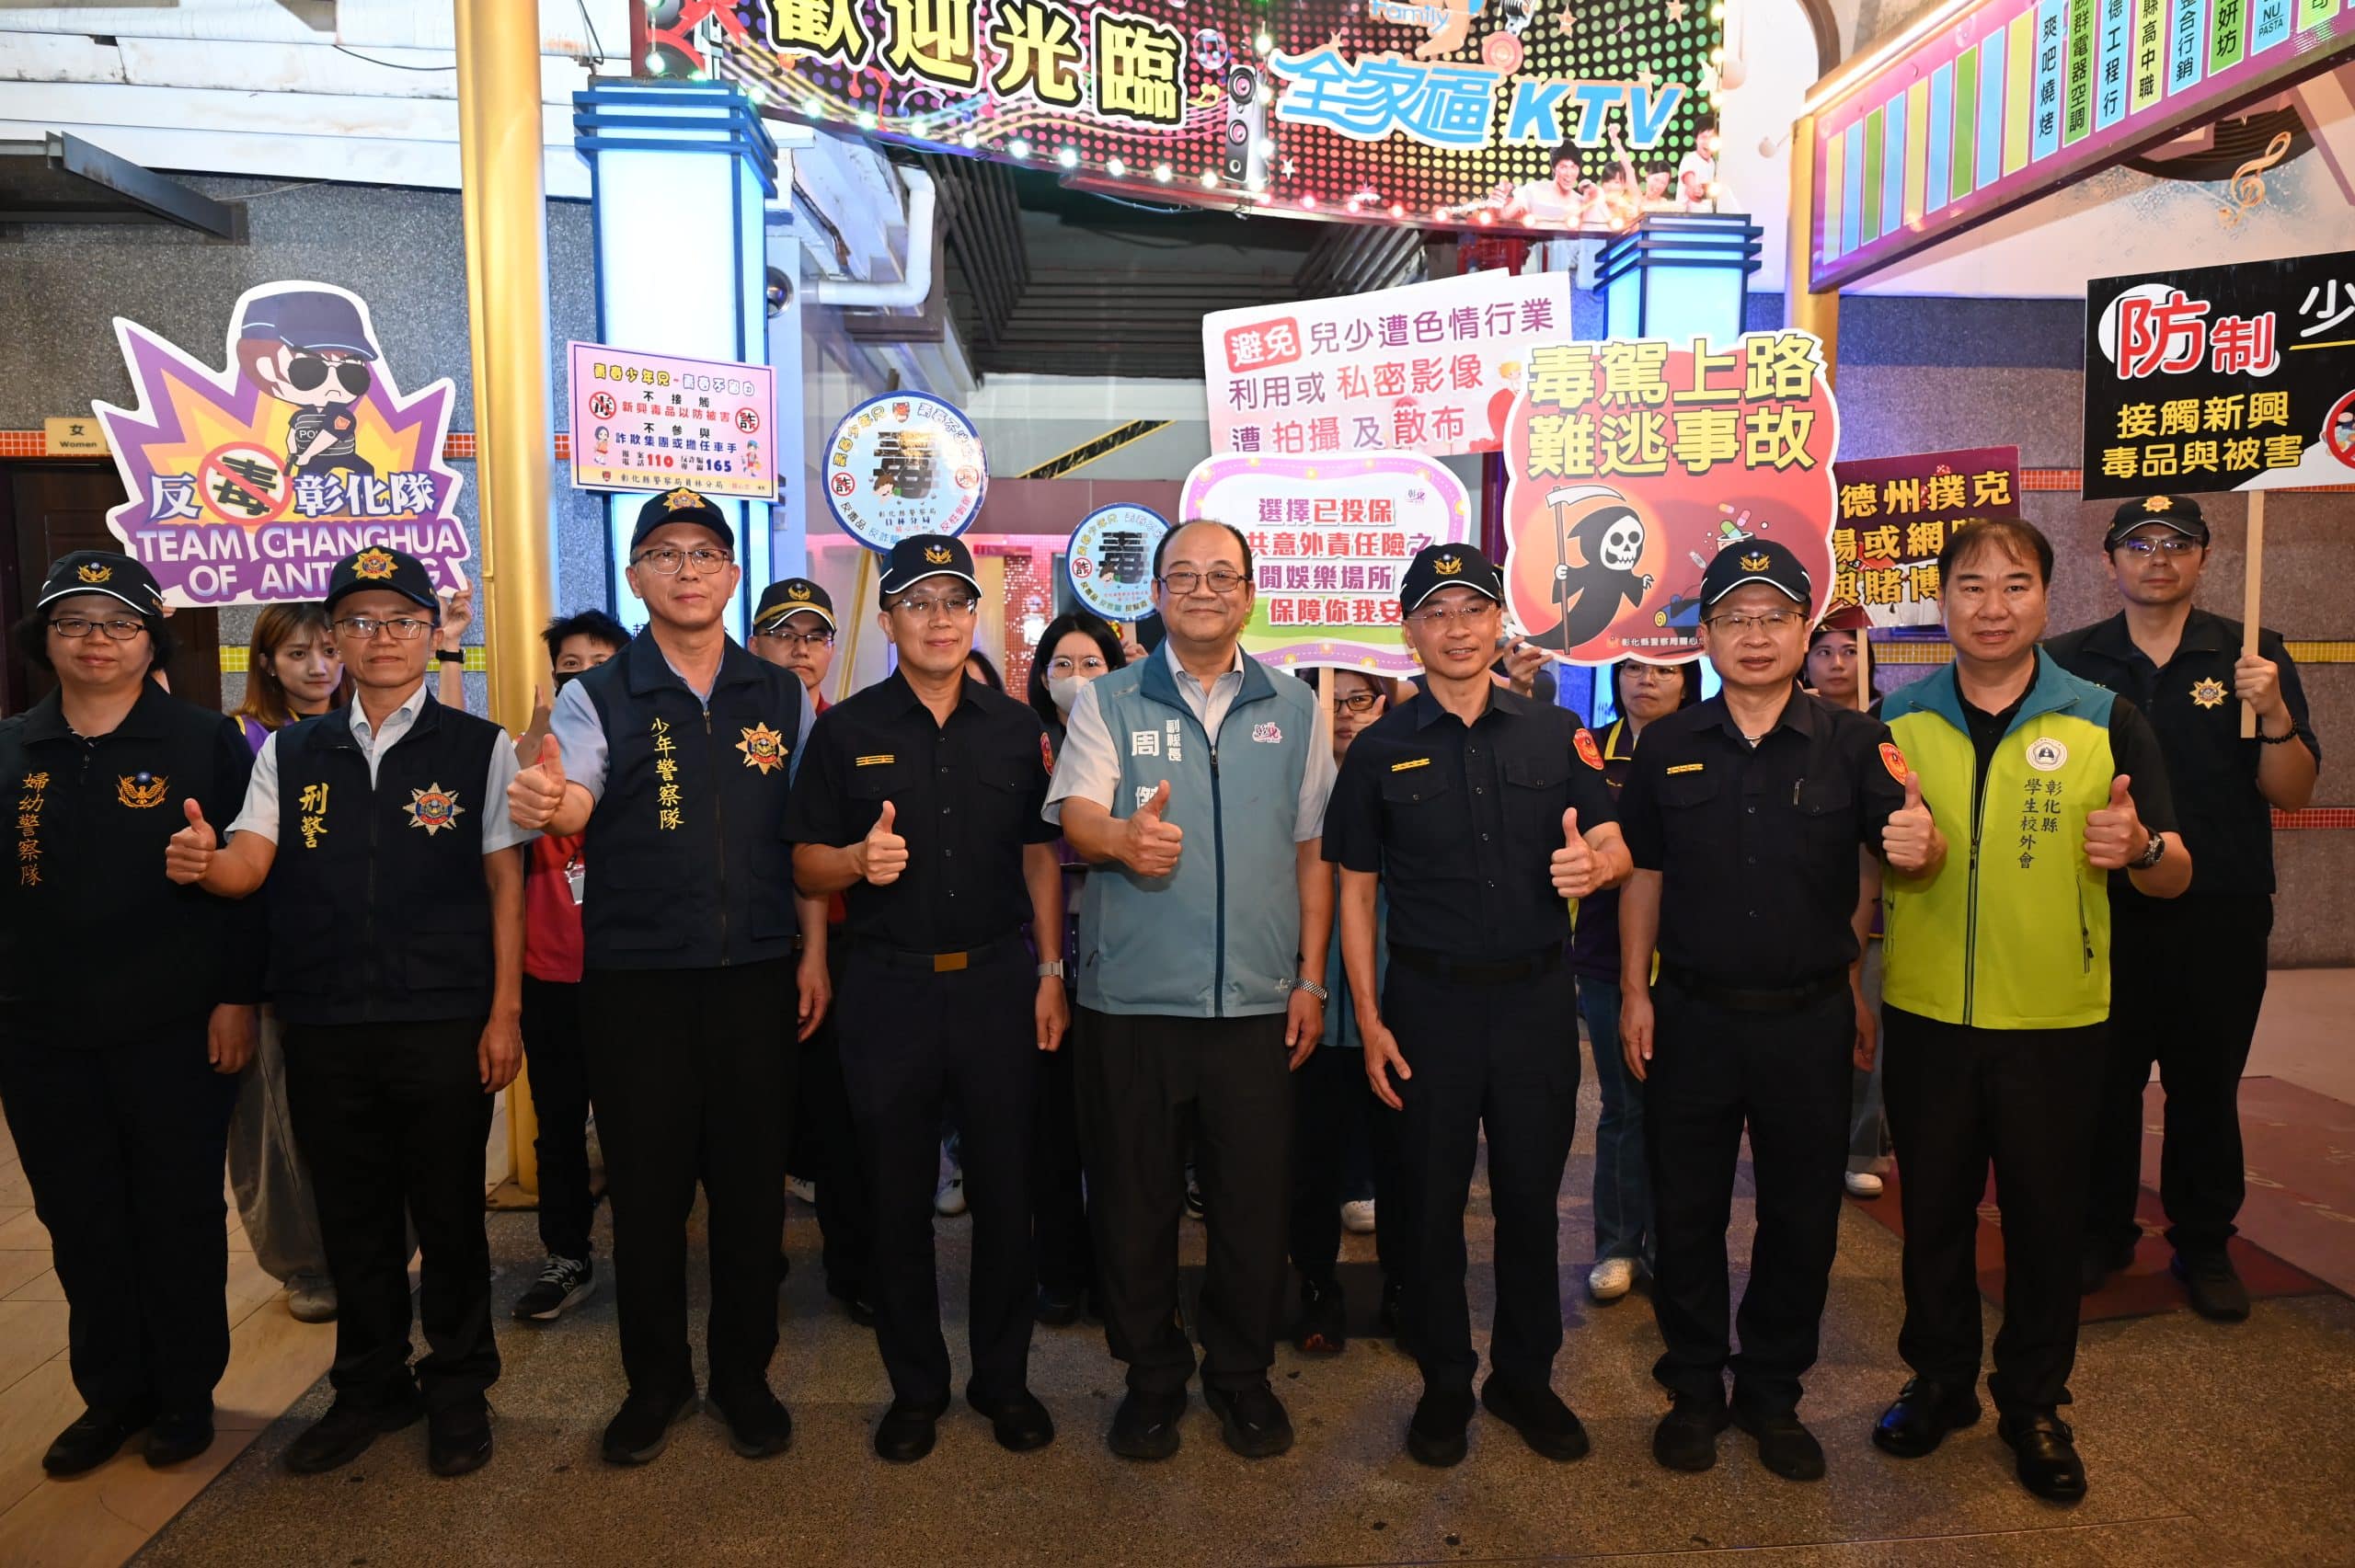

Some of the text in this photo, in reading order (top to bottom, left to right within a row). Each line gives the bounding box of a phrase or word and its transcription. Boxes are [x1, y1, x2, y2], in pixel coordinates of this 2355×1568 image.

[2215, 0, 2239, 58] 妍坊
[2258, 18, 2284, 38] PASTA
[2262, 2, 2281, 22] NU
[771, 0, 1185, 123] 歡迎光臨
[2039, 14, 2059, 138] 爽吧燒烤
[1273, 50, 1685, 145] 全家福 KTV
[1229, 297, 1555, 369] 避免 兒少遭色情行業
[2117, 279, 2355, 381] 防制 少
[1228, 353, 1484, 412] 利用或 私密影像
[1527, 334, 1820, 410] 毒駕上路
[69, 423, 85, 436] 女
[1271, 417, 1341, 452] 拍攝
[1353, 415, 1383, 449] 及
[1393, 405, 1466, 445] 散布
[2117, 390, 2290, 440] 接觸新興
[647, 453, 674, 468] 110
[706, 458, 732, 473] 165
[1527, 405, 1817, 479] 難逃事故
[2101, 433, 2303, 479] 毒品與被害
[1258, 498, 1393, 523] 選擇已投保
[1840, 470, 2012, 519] 德州撲克
[136, 524, 461, 562] TEAM CHANGHUA
[1833, 518, 1987, 563] 場或網
[189, 565, 237, 597] OF
[1258, 565, 1392, 590] 閒娛樂場所
[1269, 598, 1404, 624] 保障你我安
[650, 717, 685, 831] 少年警察隊
[15, 771, 51, 887] 婦幼警察隊
[298, 782, 329, 849] 刑警
[2017, 778, 2042, 869] 學生校外會
[2040, 779, 2063, 833] 彰化縣
